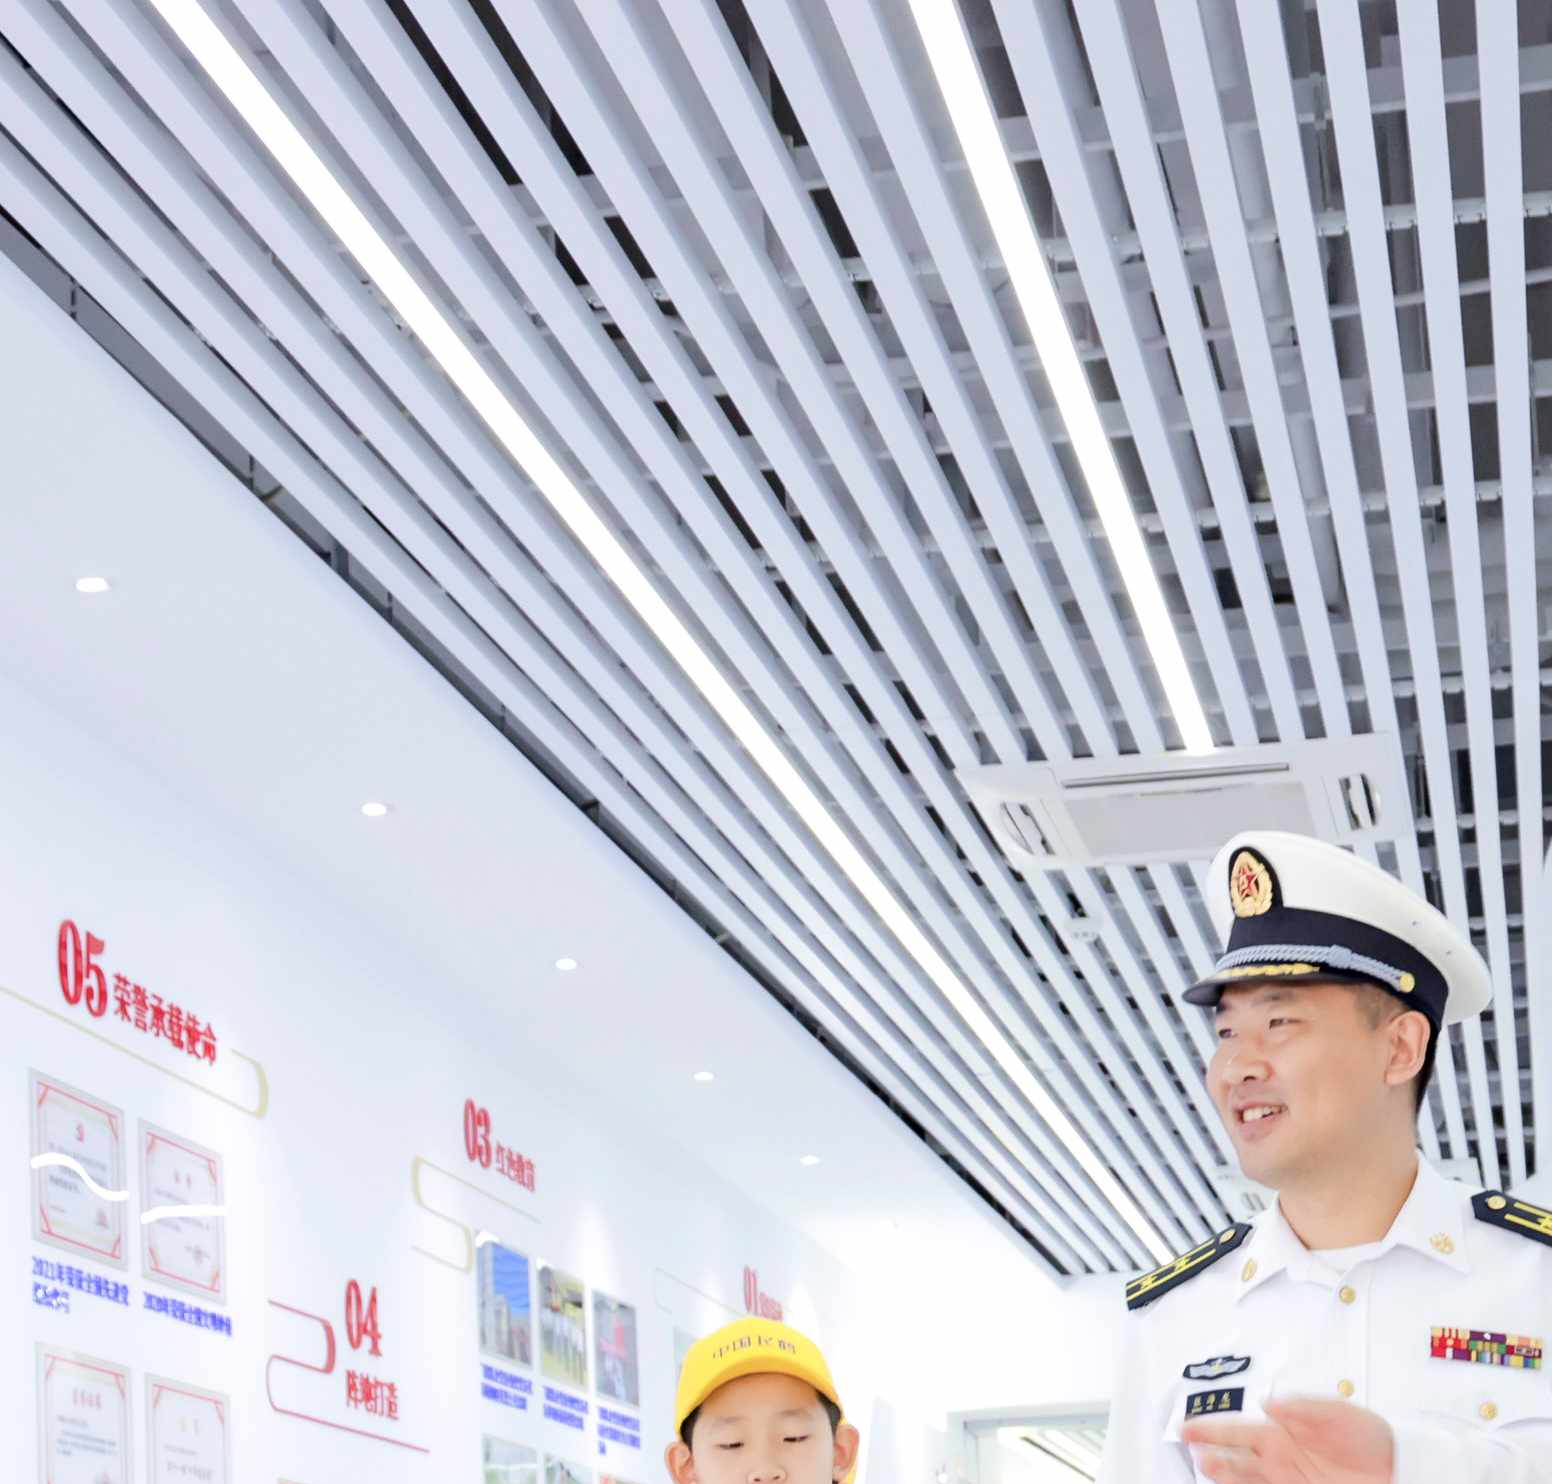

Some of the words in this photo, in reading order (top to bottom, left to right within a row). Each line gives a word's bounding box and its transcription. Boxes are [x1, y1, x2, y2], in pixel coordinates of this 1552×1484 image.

[57, 919, 108, 1018] 05
[112, 972, 217, 1066] 荣誉承载使命
[463, 1098, 492, 1169] 03
[345, 1279, 382, 1356] 04
